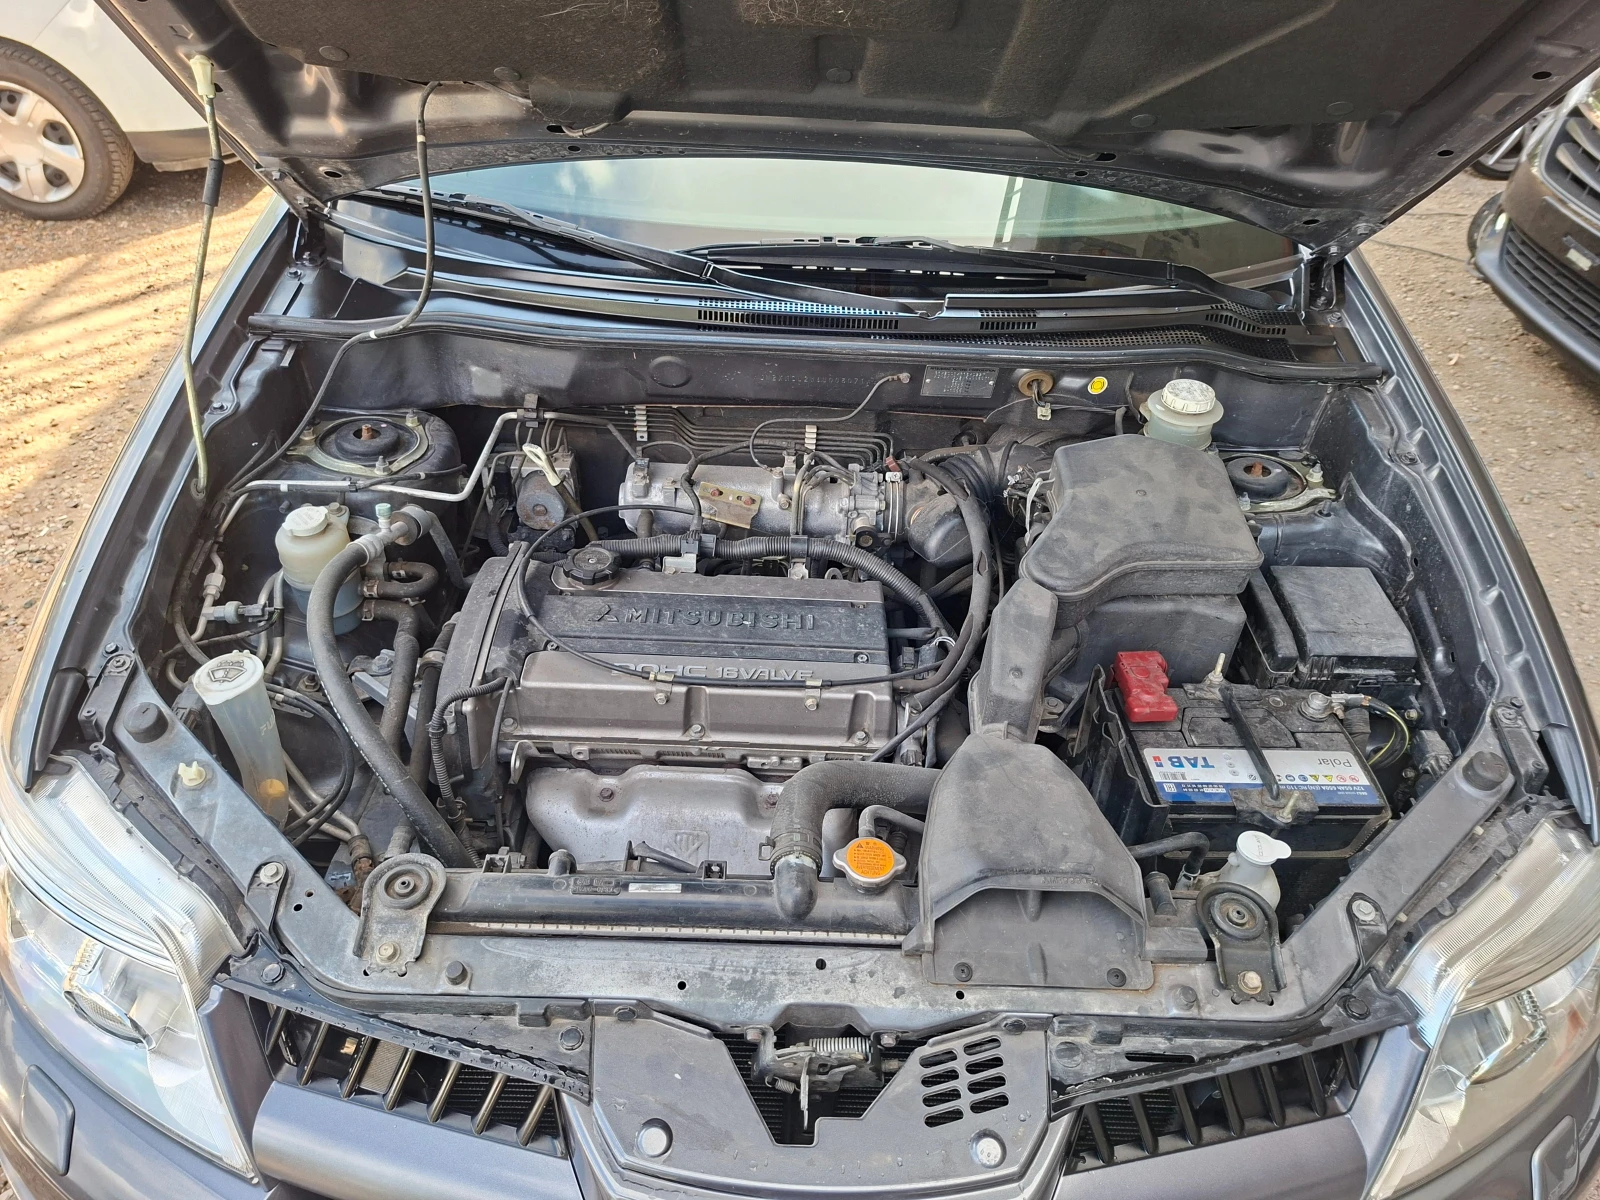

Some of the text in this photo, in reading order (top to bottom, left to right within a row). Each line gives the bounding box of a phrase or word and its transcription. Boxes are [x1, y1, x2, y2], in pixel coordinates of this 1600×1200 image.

[624, 608, 815, 630] MITSUBISHI
[1167, 755, 1215, 769] TAB
[1317, 758, 1352, 768] Polar
